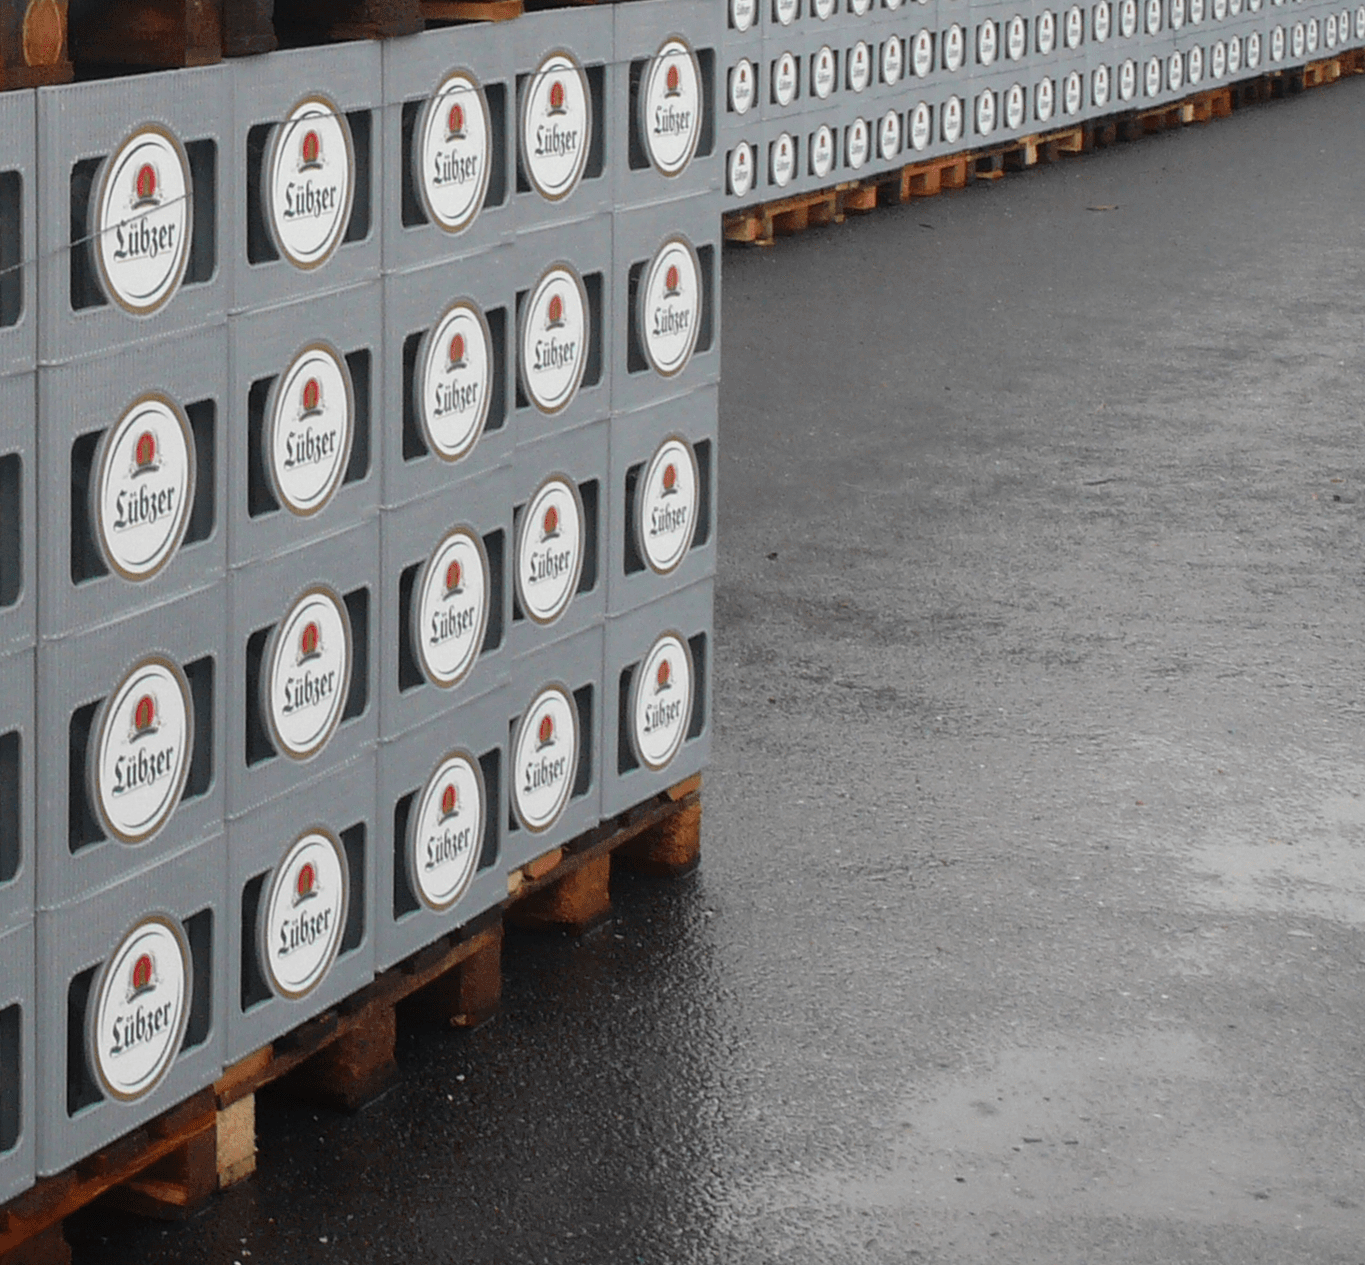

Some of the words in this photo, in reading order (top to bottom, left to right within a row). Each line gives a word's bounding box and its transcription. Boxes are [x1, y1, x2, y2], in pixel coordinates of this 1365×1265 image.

[535, 124, 578, 157] Lübzer
[433, 150, 478, 186] Lübzer
[283, 180, 337, 219] Lübzer
[114, 217, 175, 260] Lübzer
[533, 337, 575, 372] Lübzer
[434, 379, 478, 418] Lübzer
[284, 427, 336, 469] Lübzer
[113, 485, 175, 531] Lübzer
[529, 548, 571, 585] Lübzer
[430, 605, 475, 646] Lübzer
[282, 670, 335, 715] Lübzer
[112, 746, 174, 796] Lübzer
[523, 756, 566, 795] Lübzer
[425, 827, 471, 871] Lübzer
[278, 908, 331, 957] Lübzer
[110, 1002, 171, 1057] Lübzer
